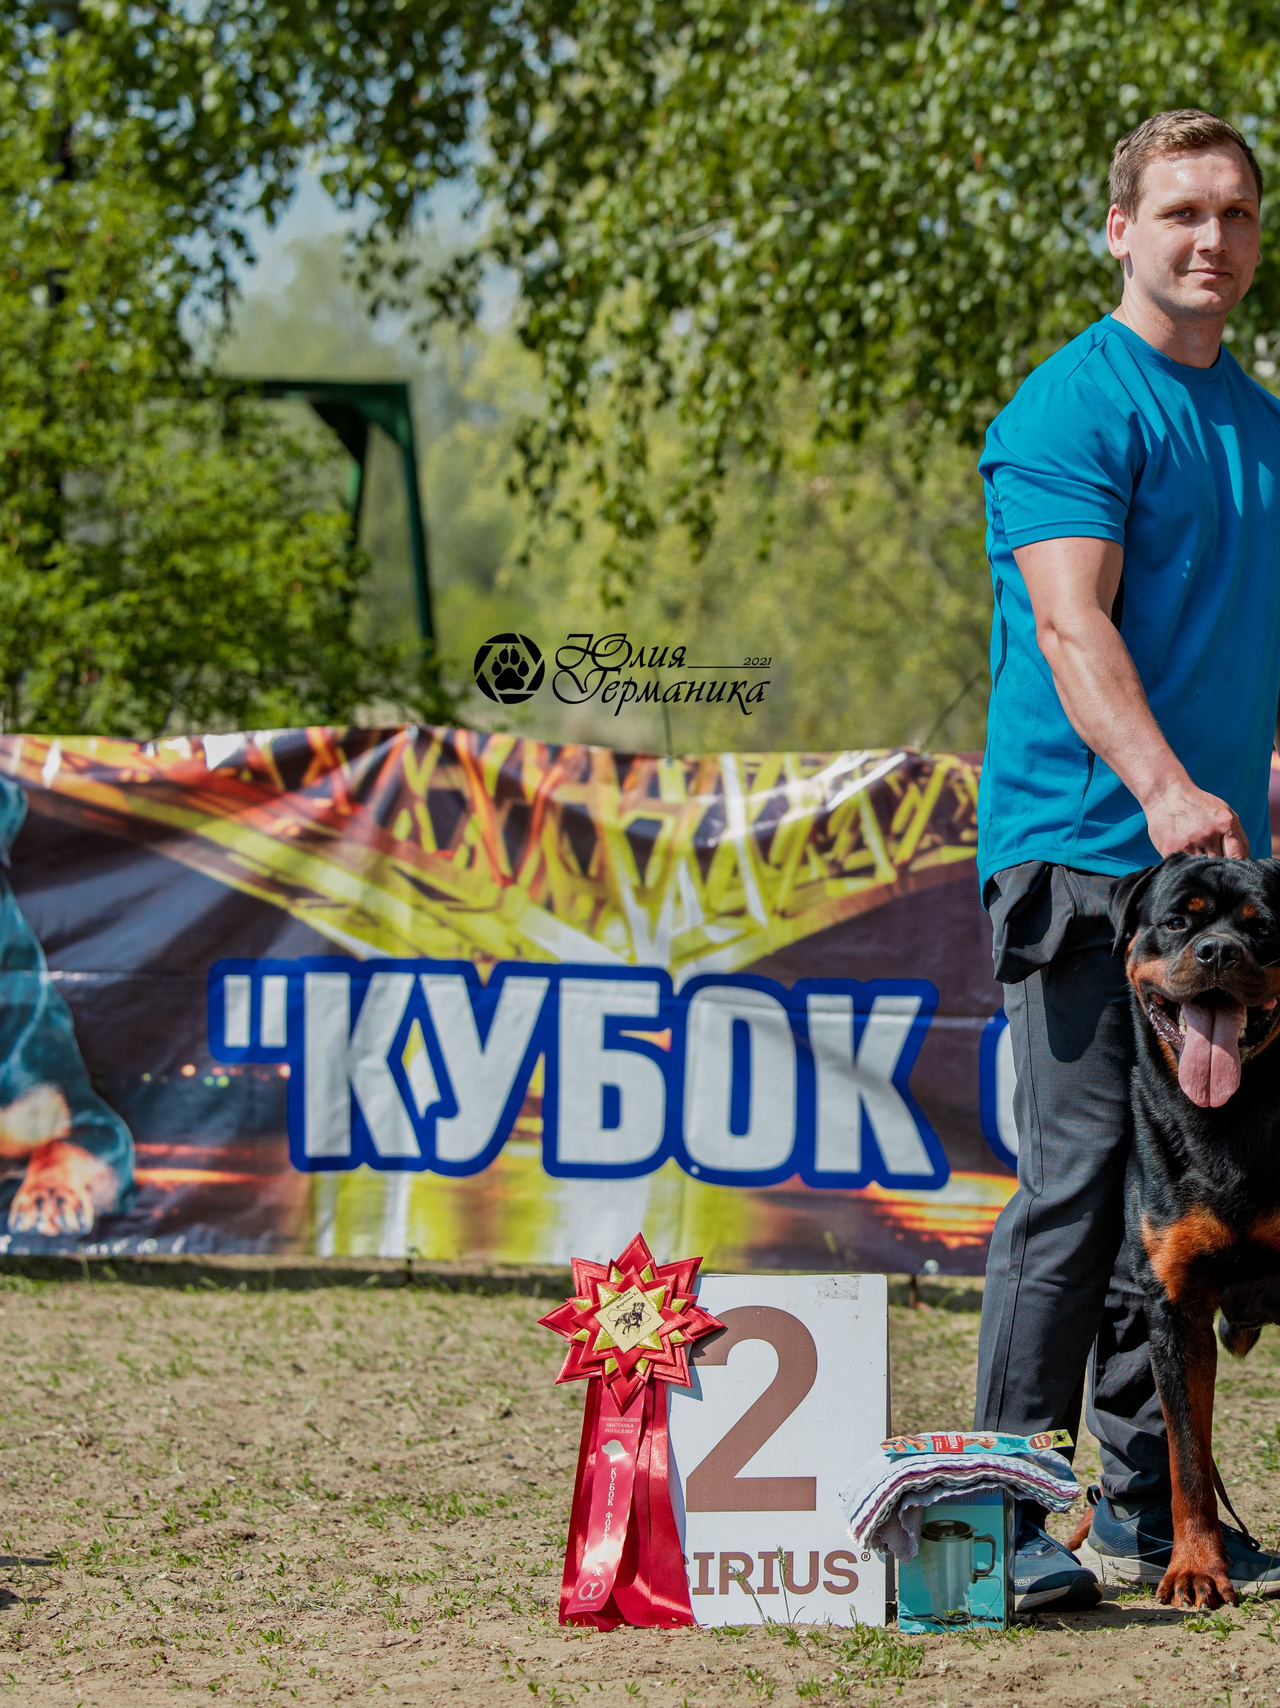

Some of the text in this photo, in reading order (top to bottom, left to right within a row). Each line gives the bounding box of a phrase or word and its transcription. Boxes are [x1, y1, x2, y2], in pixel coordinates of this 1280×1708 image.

[223, 971, 936, 1177] "КУБОК
[607, 1467, 617, 1506] КУБОК
[686, 1305, 818, 1512] 2
